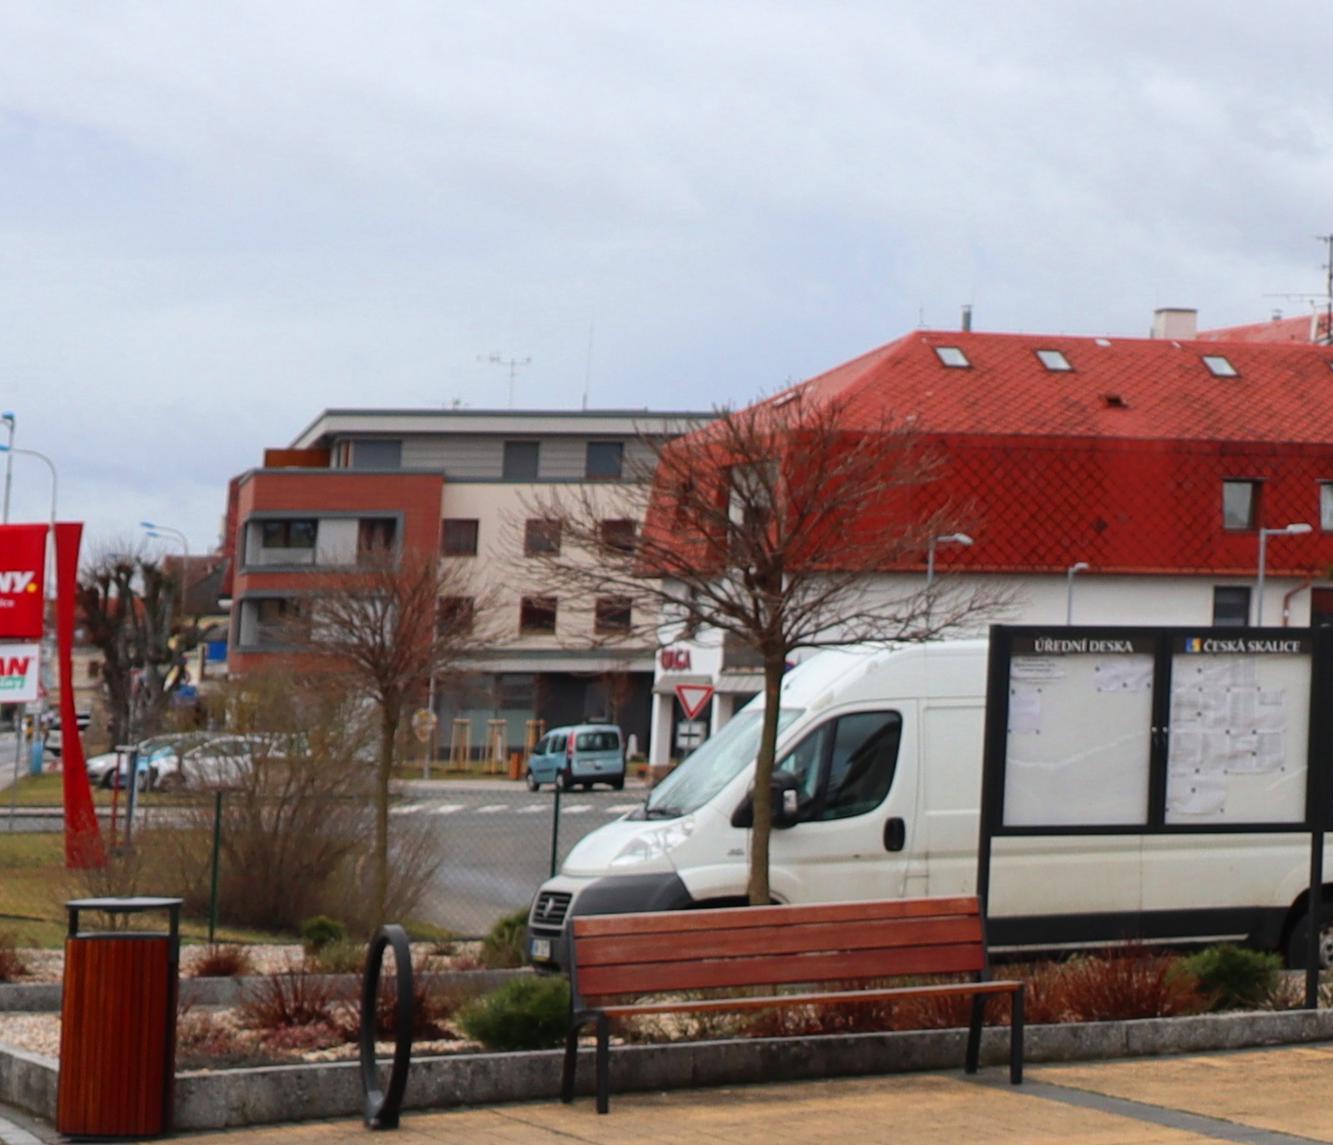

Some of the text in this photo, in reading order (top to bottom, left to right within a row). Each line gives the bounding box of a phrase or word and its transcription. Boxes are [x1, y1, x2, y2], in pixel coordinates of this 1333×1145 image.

[1034, 637, 1133, 652] ÚŘEDNÍ DESKA
[1203, 638, 1300, 653] ČESKÁ SKALICE
